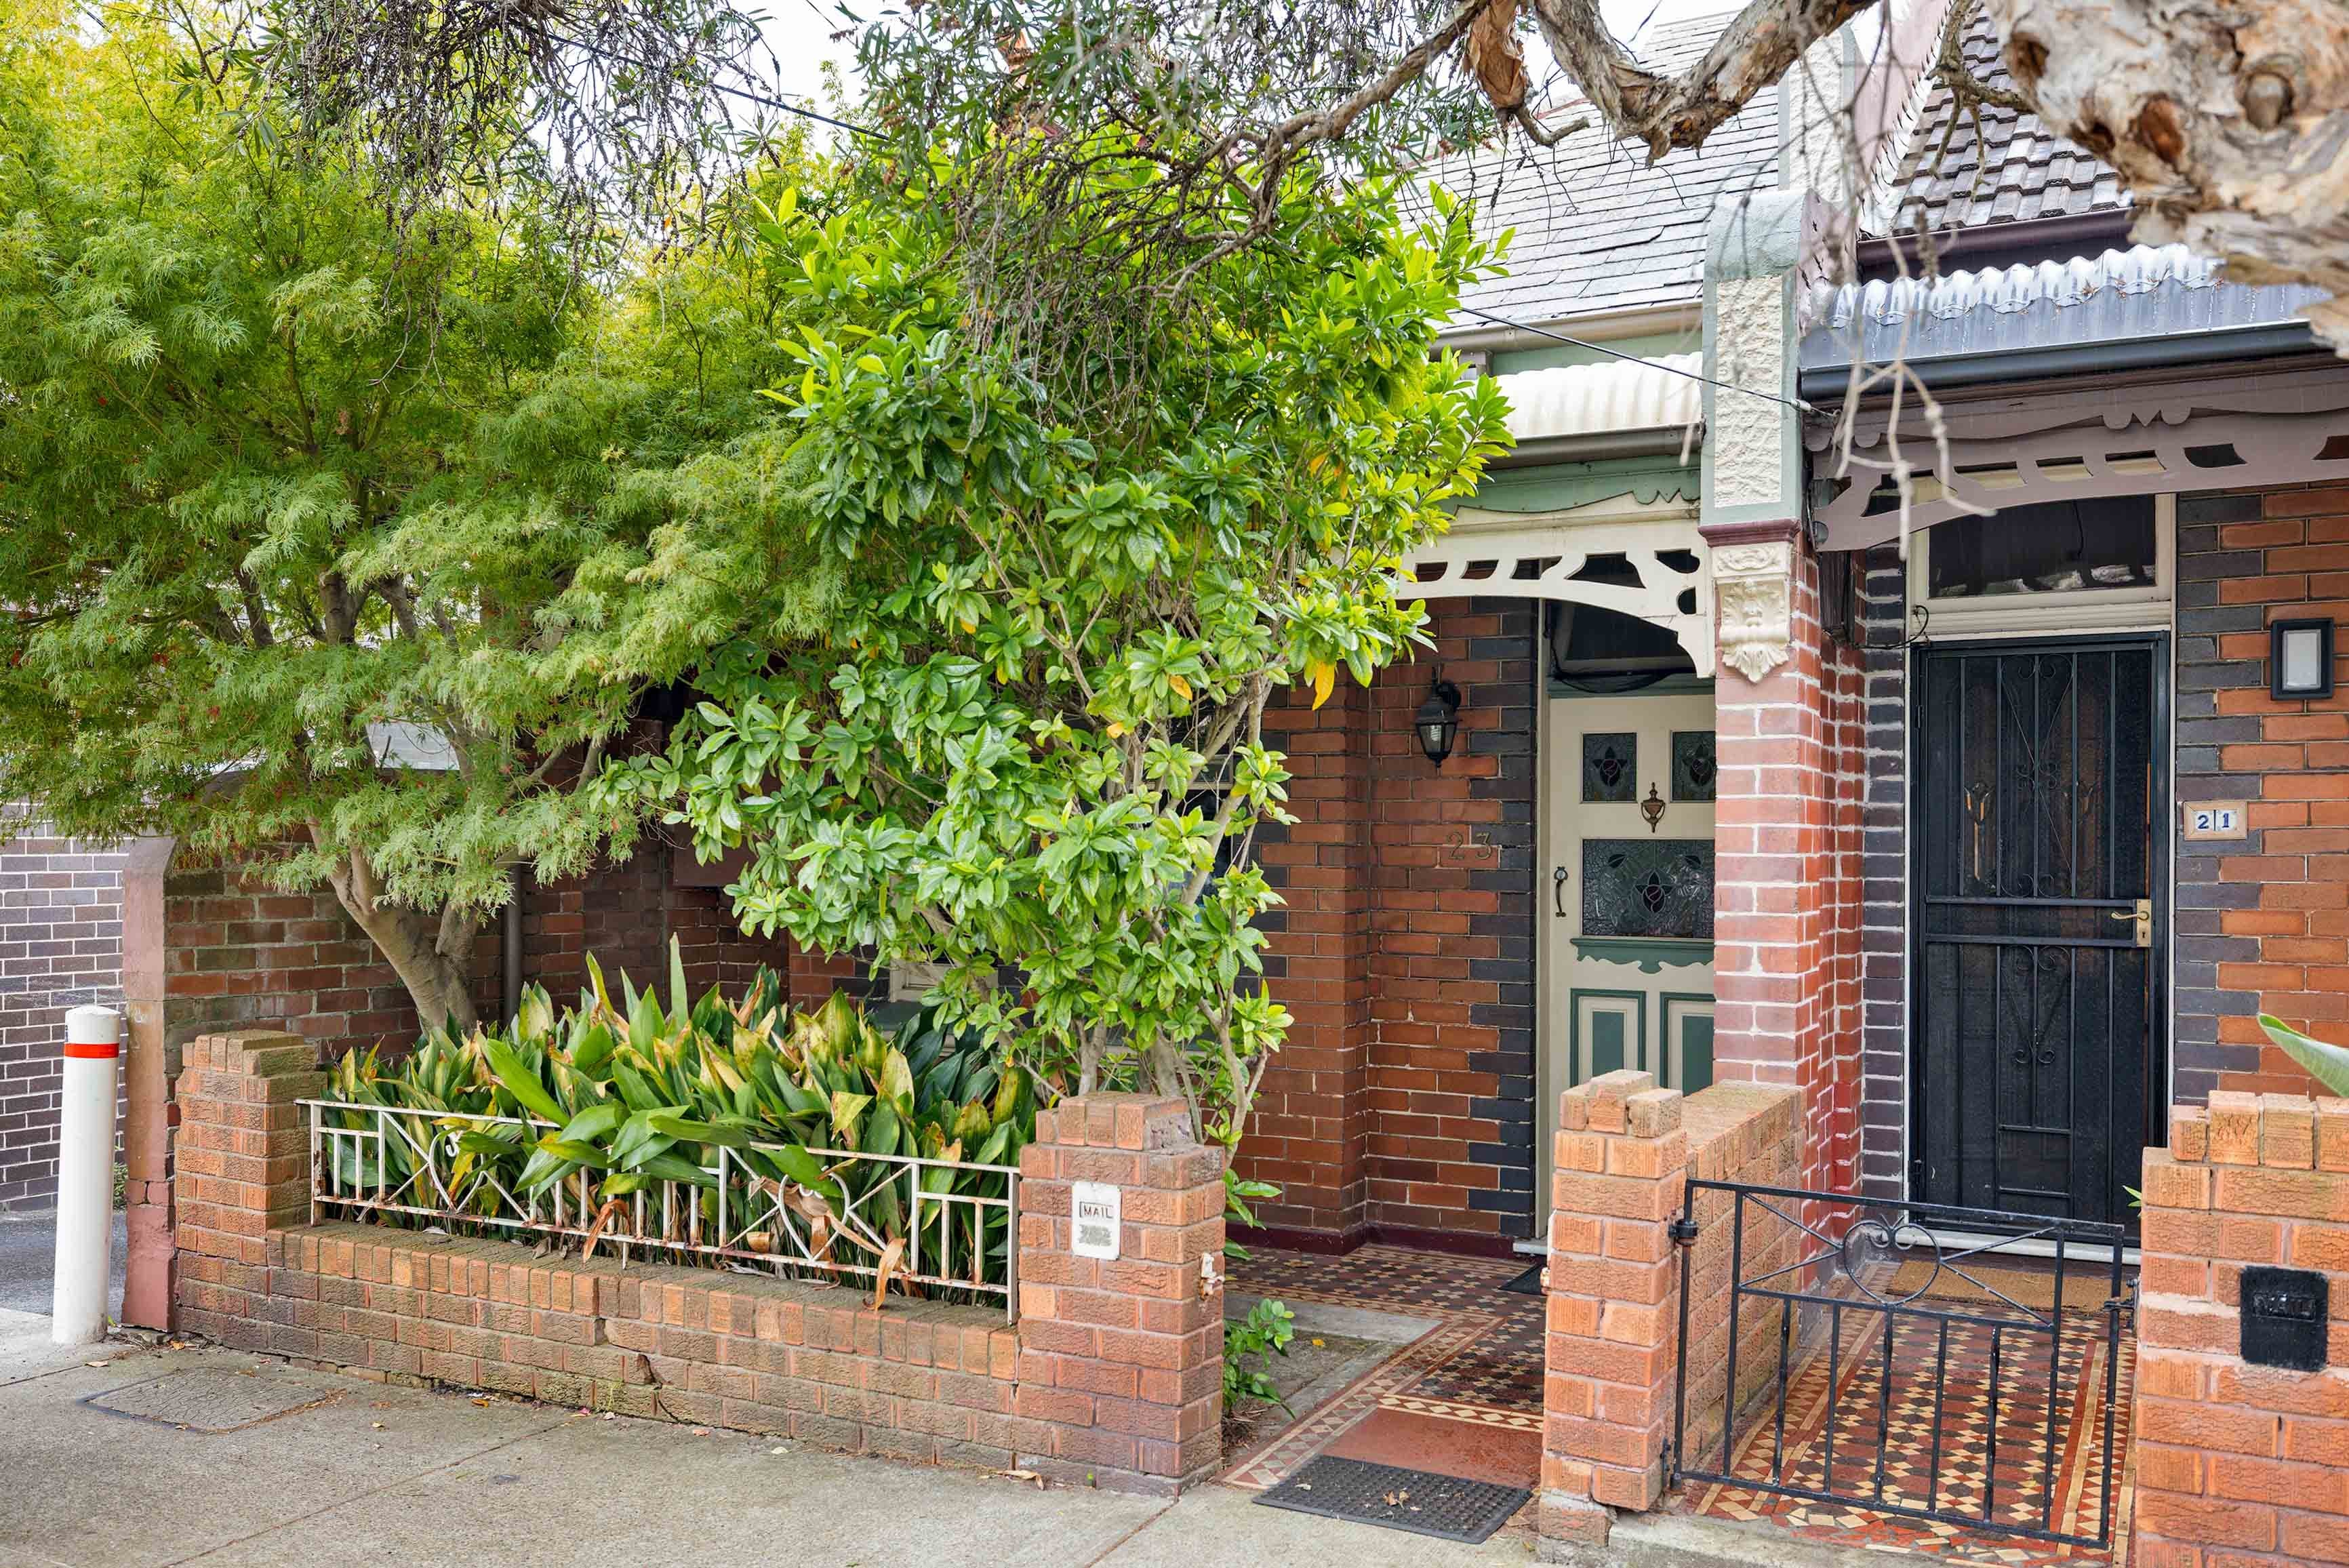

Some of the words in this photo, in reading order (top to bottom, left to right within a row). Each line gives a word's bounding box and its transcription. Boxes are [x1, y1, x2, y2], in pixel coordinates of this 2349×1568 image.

[2198, 813, 2230, 829] 21
[1448, 831, 1492, 859] 23
[1083, 1205, 1113, 1218] MAIL
